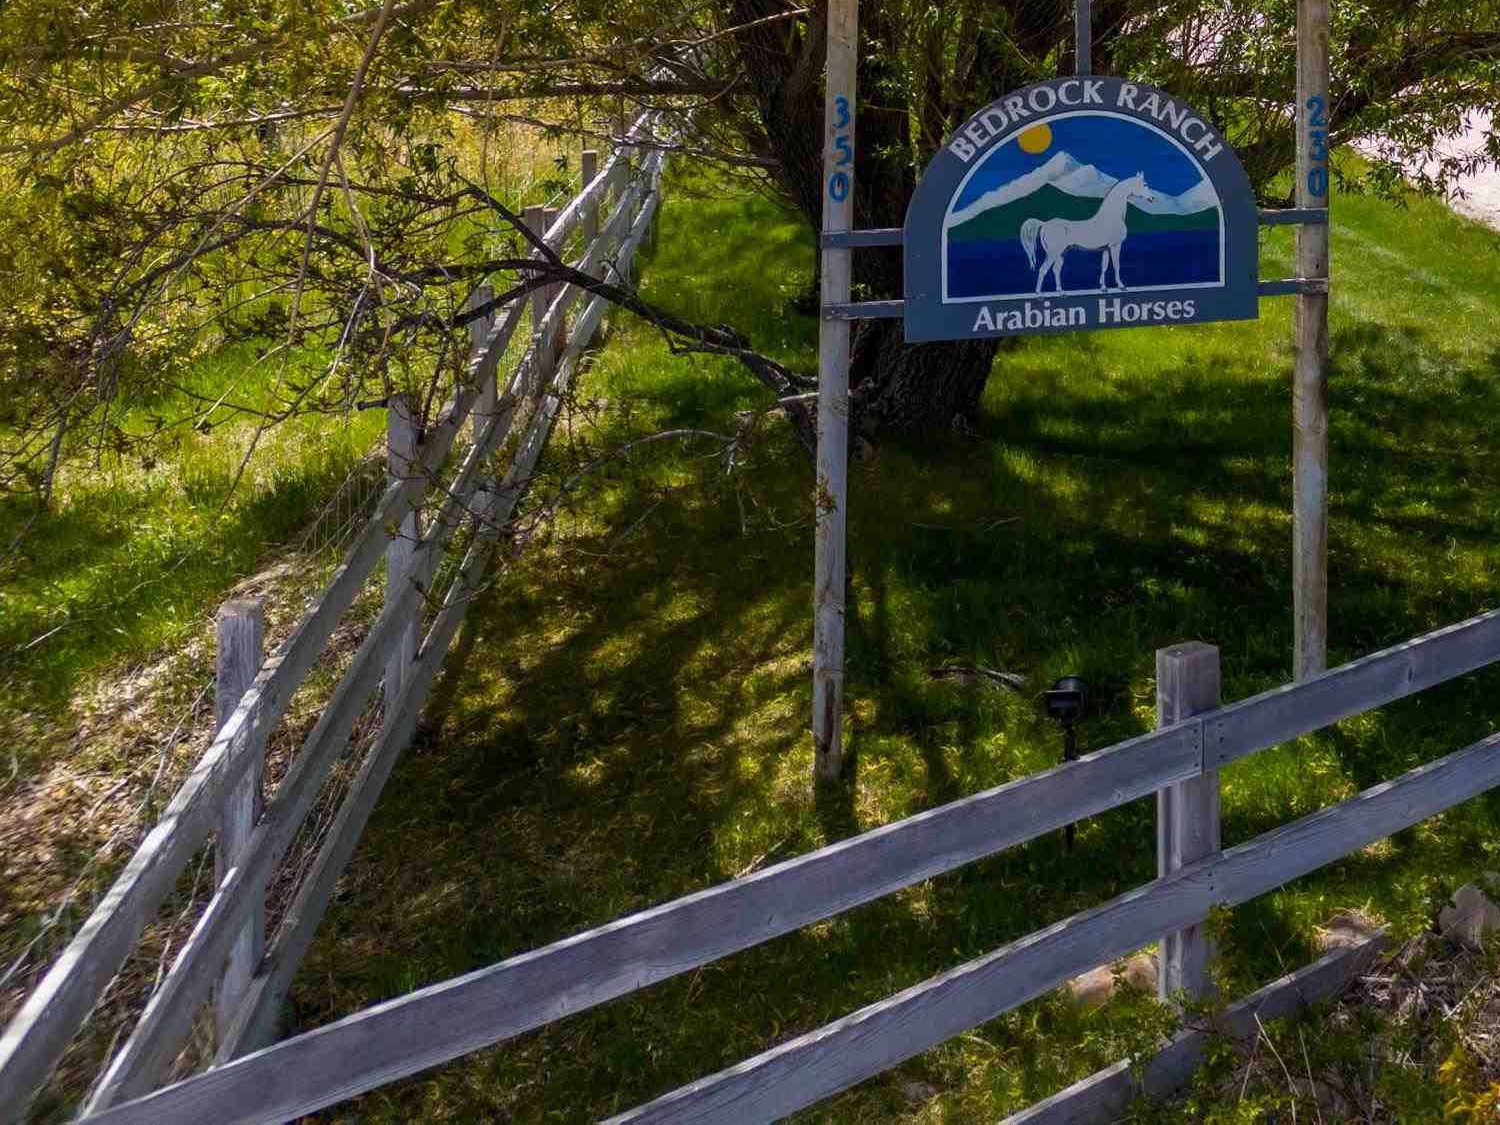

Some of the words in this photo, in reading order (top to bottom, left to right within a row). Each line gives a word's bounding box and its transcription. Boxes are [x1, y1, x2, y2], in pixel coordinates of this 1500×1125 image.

[829, 96, 851, 203] 350
[949, 80, 1105, 163] BEDROCK
[1115, 82, 1224, 162] RANCH
[972, 301, 1087, 332] Arabian
[1098, 298, 1196, 319] Horses
